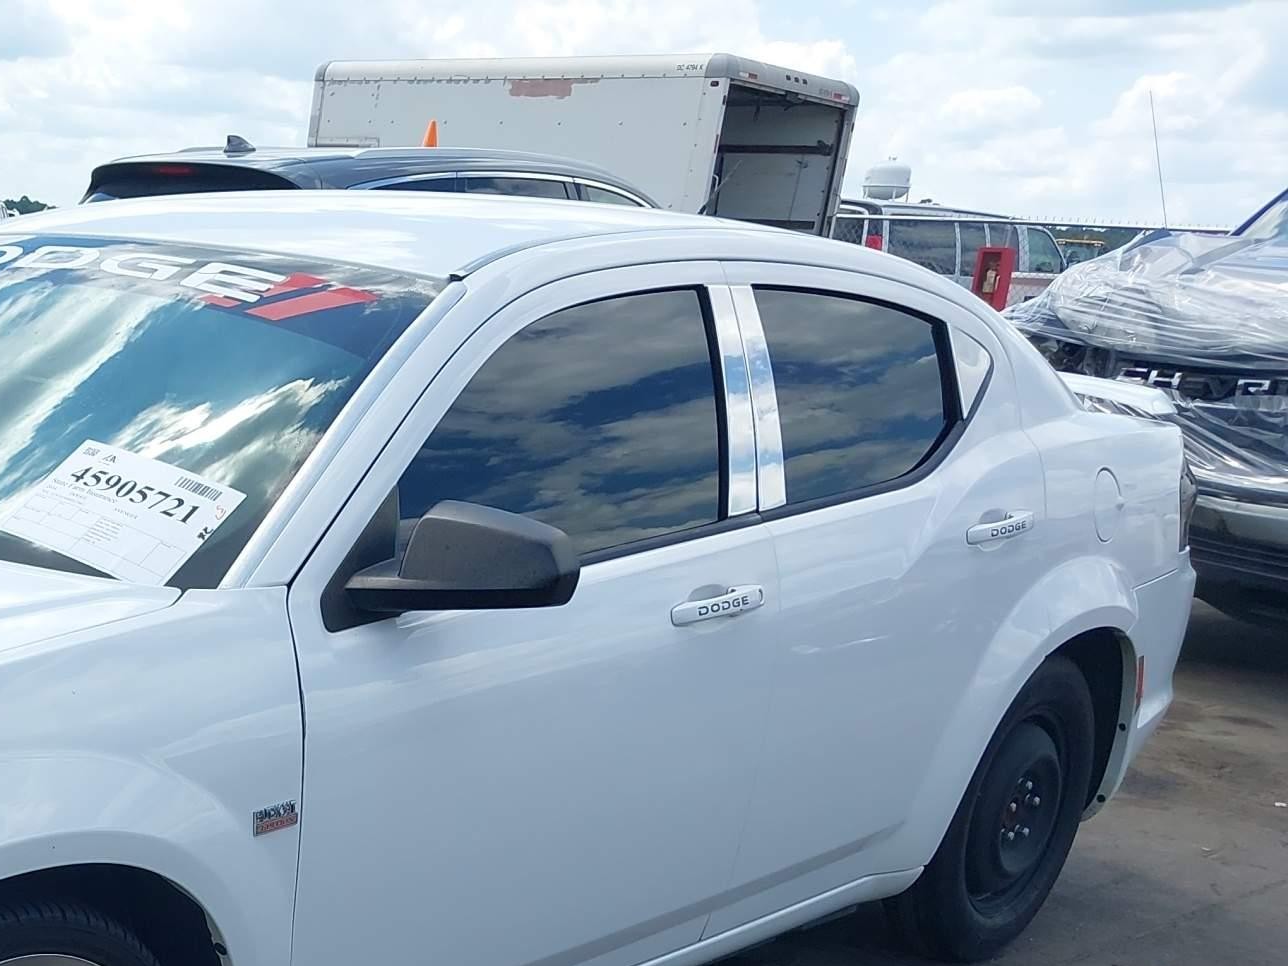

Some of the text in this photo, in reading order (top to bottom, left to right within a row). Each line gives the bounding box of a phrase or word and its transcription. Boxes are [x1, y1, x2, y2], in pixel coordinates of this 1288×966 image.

[70, 466, 200, 525] 45905721
[990, 520, 1027, 537] DODGE
[697, 595, 750, 617] DODGE
